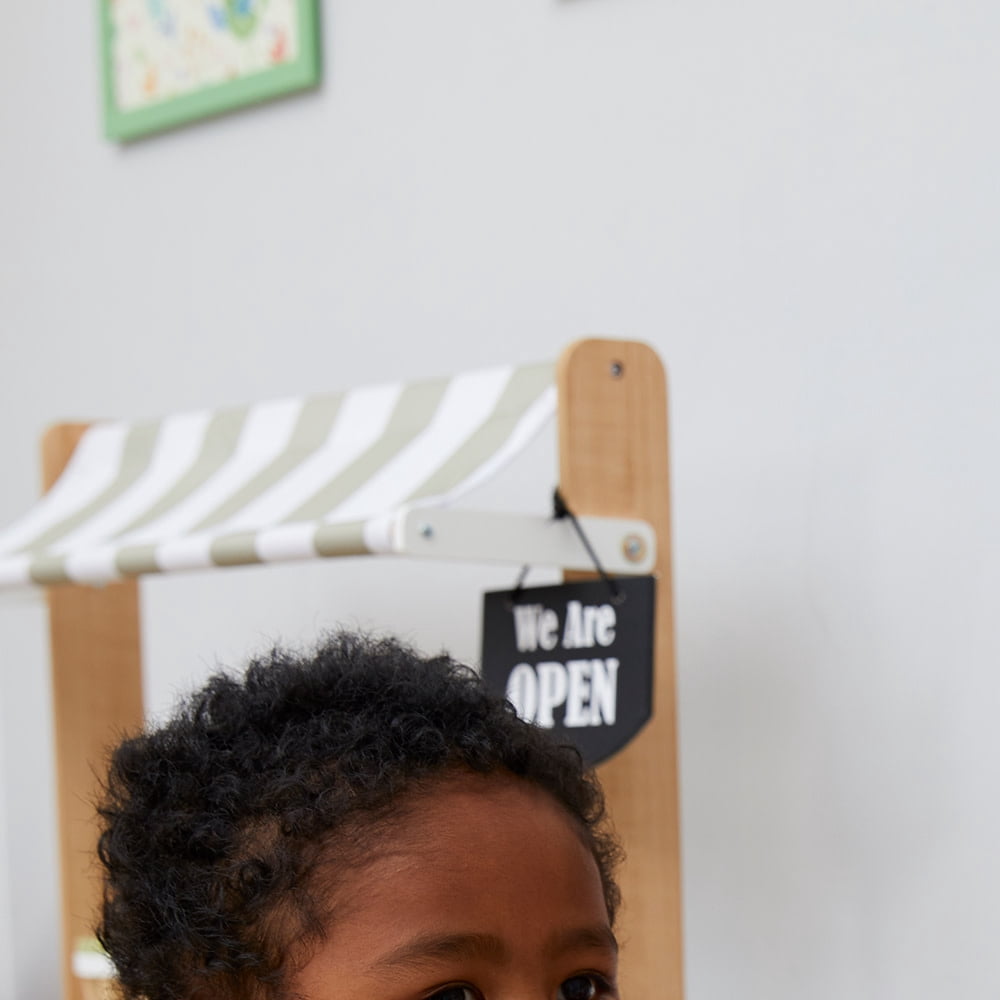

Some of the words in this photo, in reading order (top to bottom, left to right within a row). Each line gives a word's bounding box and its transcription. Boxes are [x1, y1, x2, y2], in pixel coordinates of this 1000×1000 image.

[513, 603, 559, 651] We
[562, 600, 617, 648] Are
[506, 657, 619, 728] OPEN
